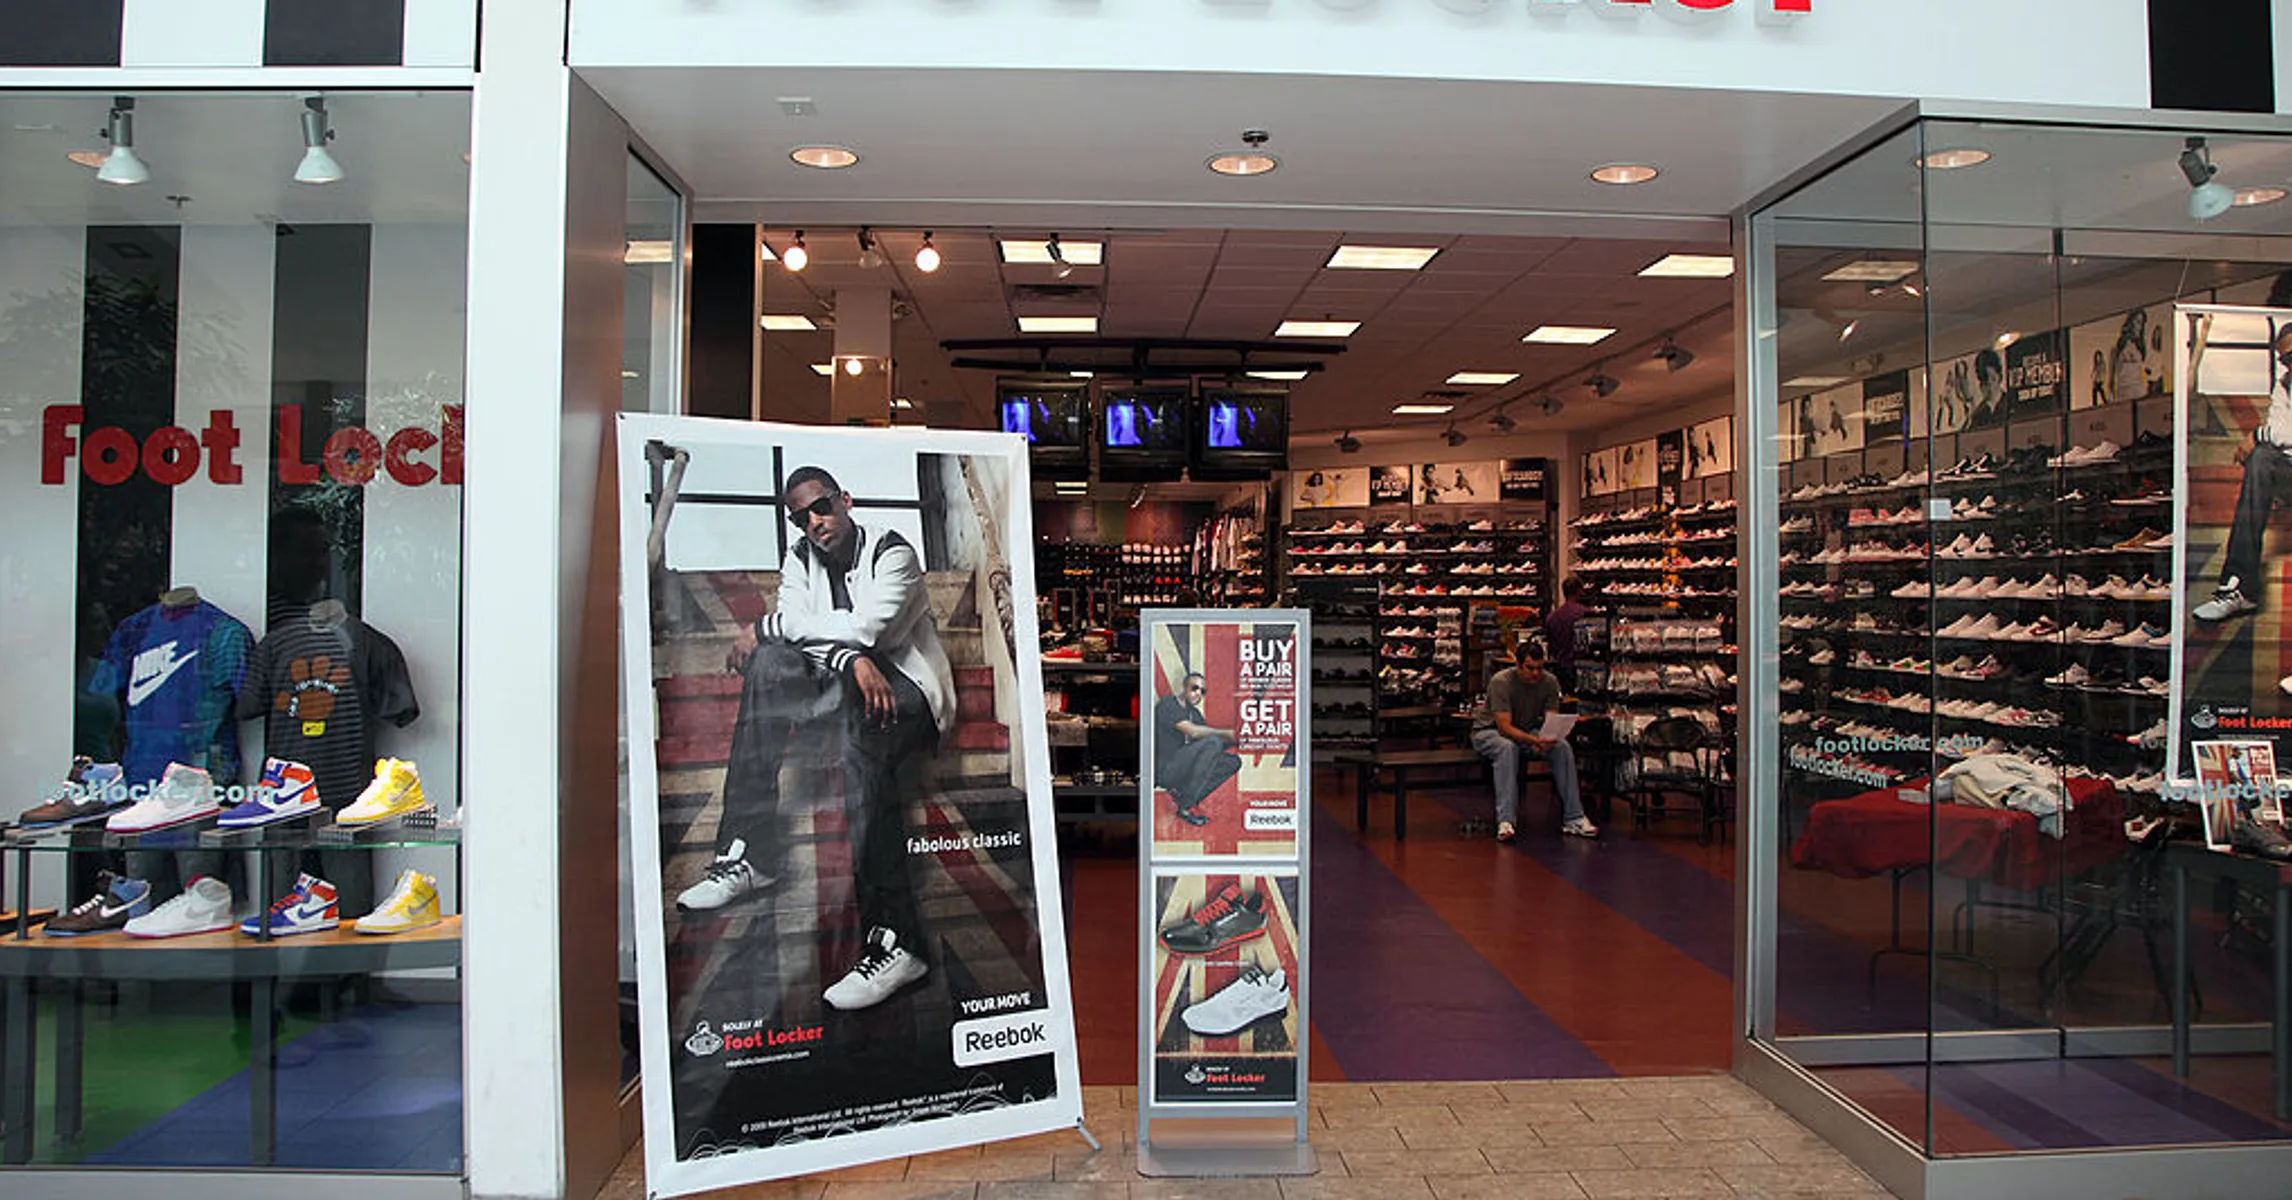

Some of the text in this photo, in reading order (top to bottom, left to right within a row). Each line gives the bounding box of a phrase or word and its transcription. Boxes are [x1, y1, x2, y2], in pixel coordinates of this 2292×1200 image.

[41, 405, 242, 485] Foot
[1240, 640, 1293, 661] BUY
[1240, 662, 1292, 677] A PAIR
[1241, 700, 1293, 721] GET
[1240, 721, 1292, 736] A PAIR
[2218, 716, 2247, 728] Foot
[1250, 814, 1292, 826] Reebok
[907, 832, 1021, 854] fabolous classic
[961, 992, 1031, 1015] YOUR MOVE
[724, 1025, 824, 1051] Foot Locker
[965, 1022, 1045, 1053] Reebok
[1206, 1073, 1265, 1083] Foot Locker
